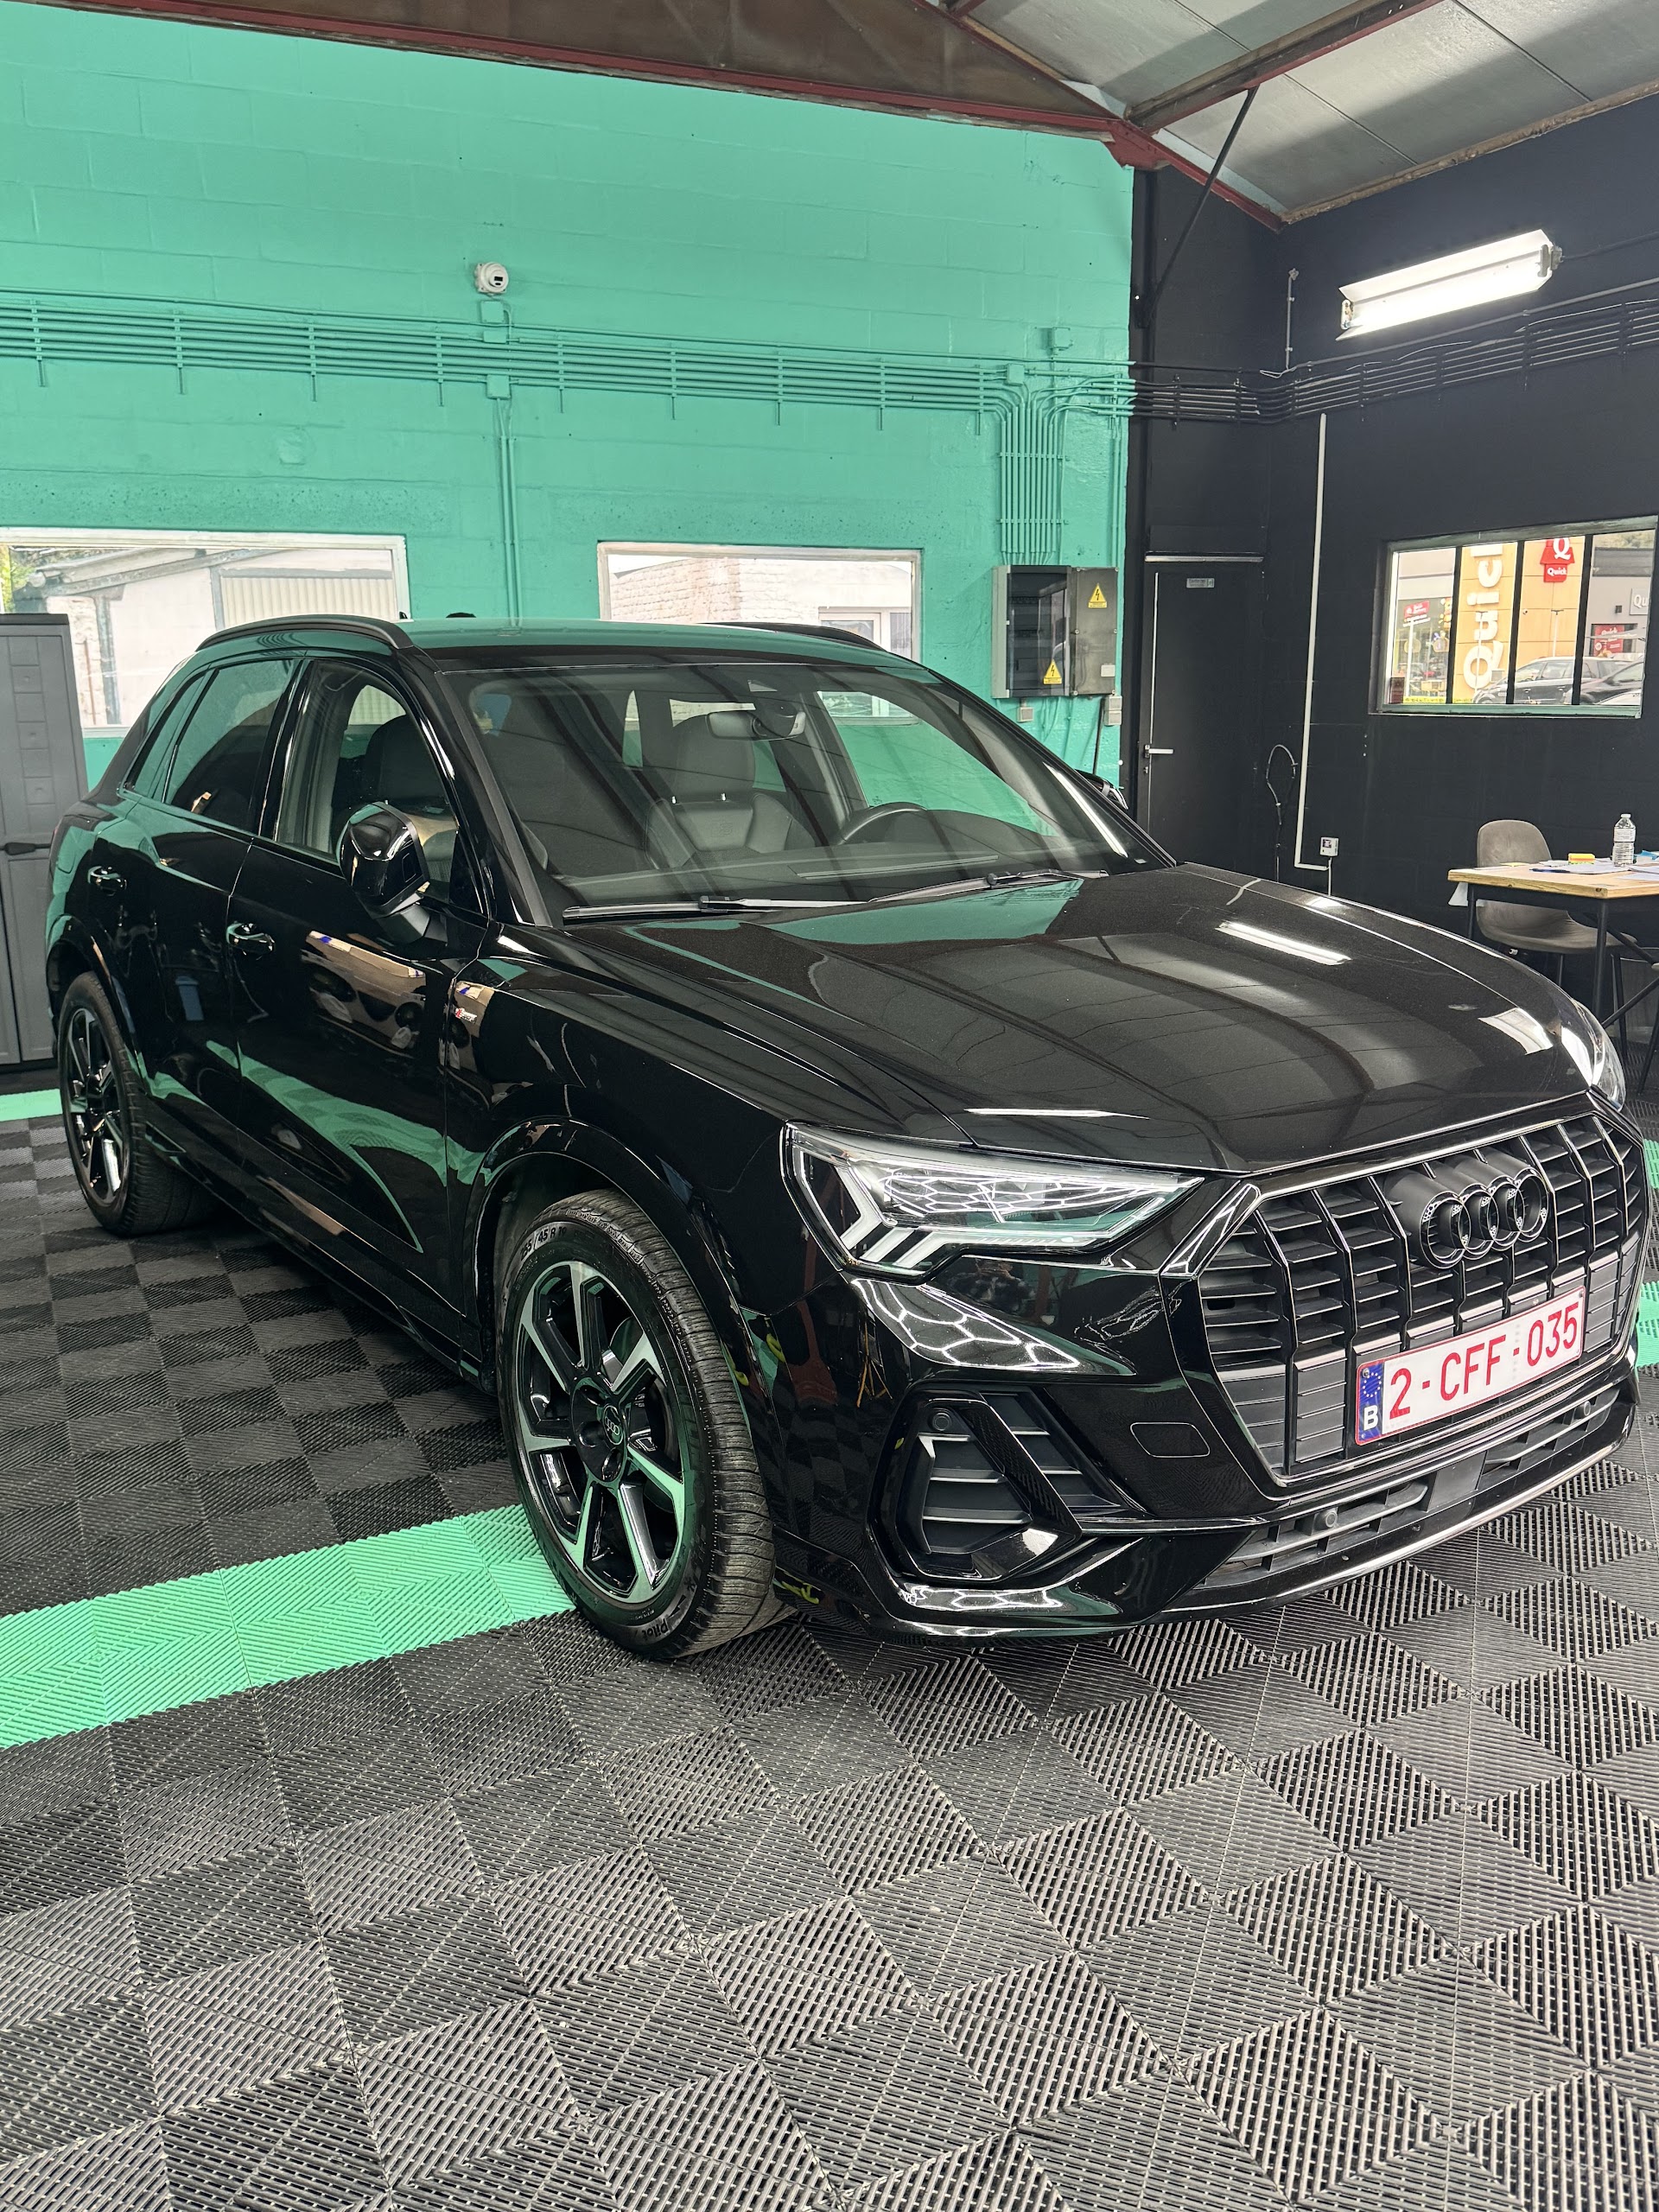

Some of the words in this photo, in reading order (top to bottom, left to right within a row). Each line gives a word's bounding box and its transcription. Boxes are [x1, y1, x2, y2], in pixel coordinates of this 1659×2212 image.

[1553, 537, 1571, 560] Q
[1389, 1301, 1580, 1420] 2-CFF-035
[1363, 1405, 1379, 1431] B
[641, 1617, 669, 1638] Pilot
